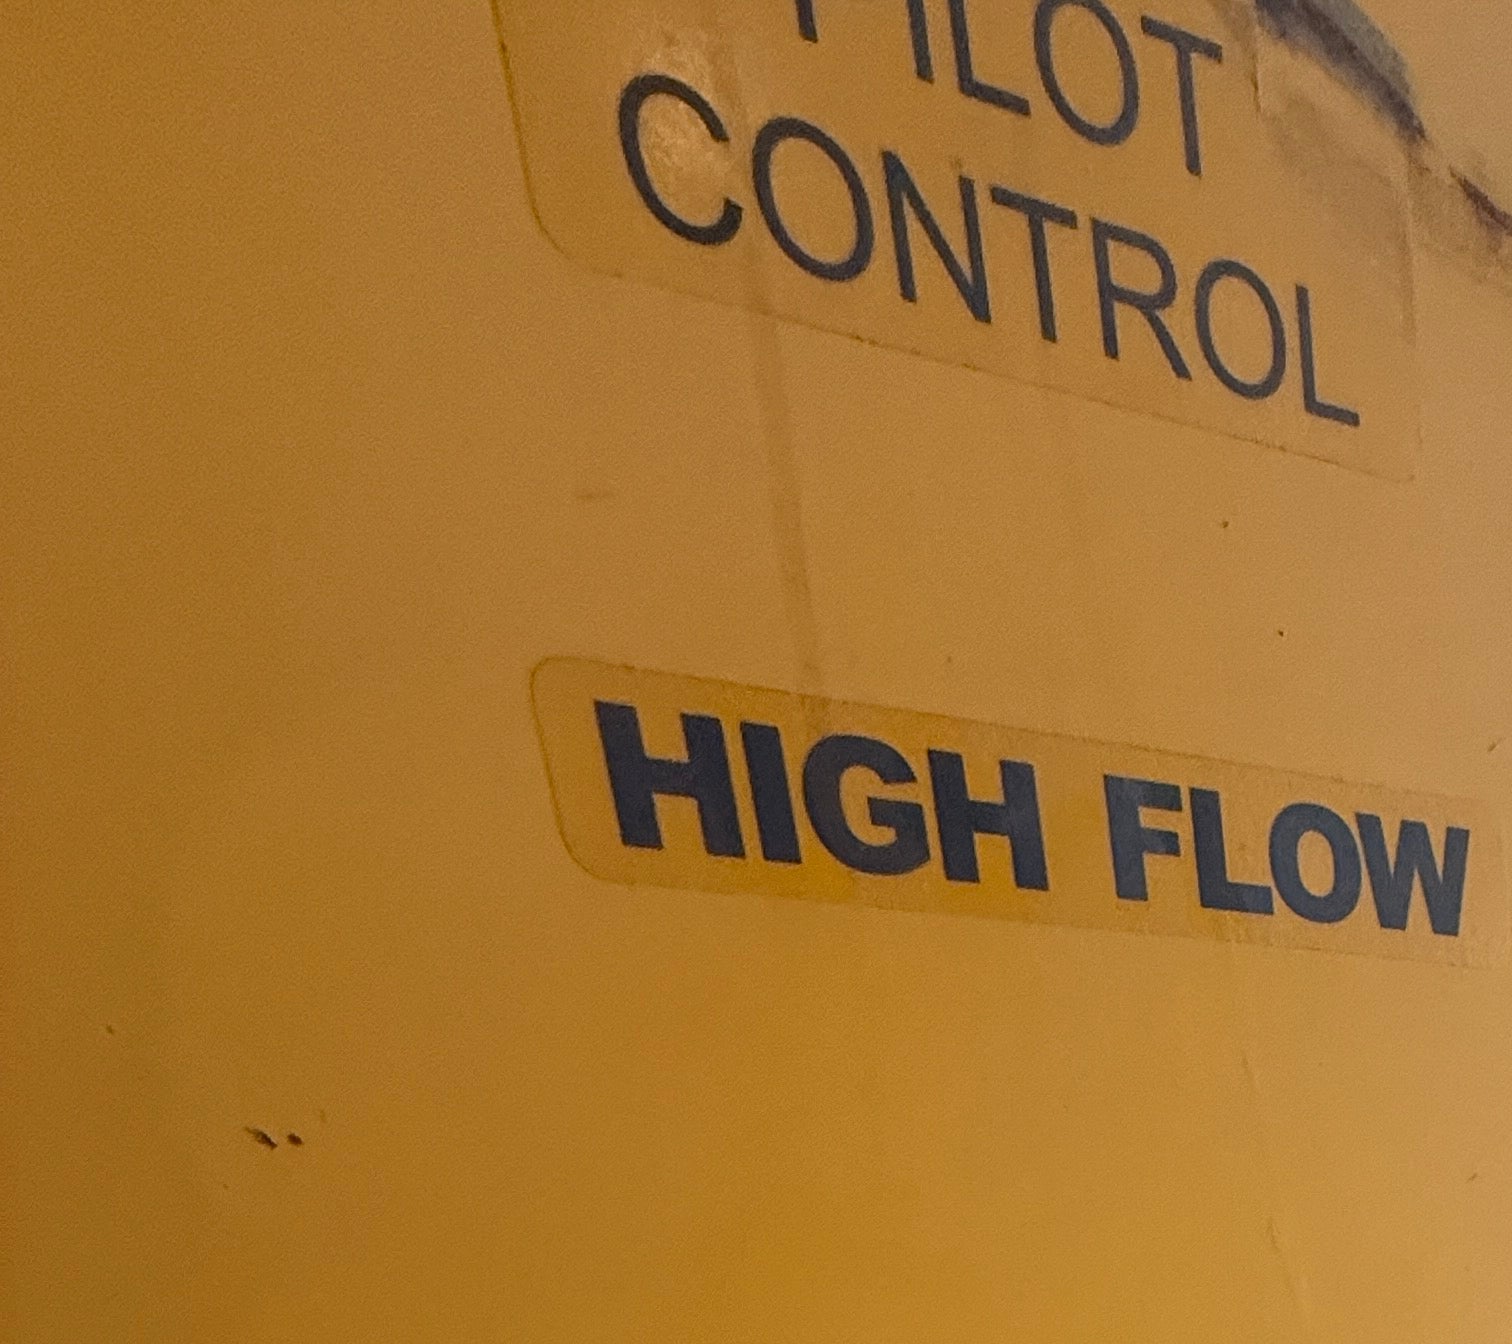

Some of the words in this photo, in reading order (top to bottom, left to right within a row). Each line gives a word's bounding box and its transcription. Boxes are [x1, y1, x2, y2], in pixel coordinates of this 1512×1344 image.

[796, 0, 1222, 177] ILOT
[617, 73, 1361, 427] CONTROL
[593, 699, 1049, 892] HIGH
[1103, 773, 1471, 938] FLOW
